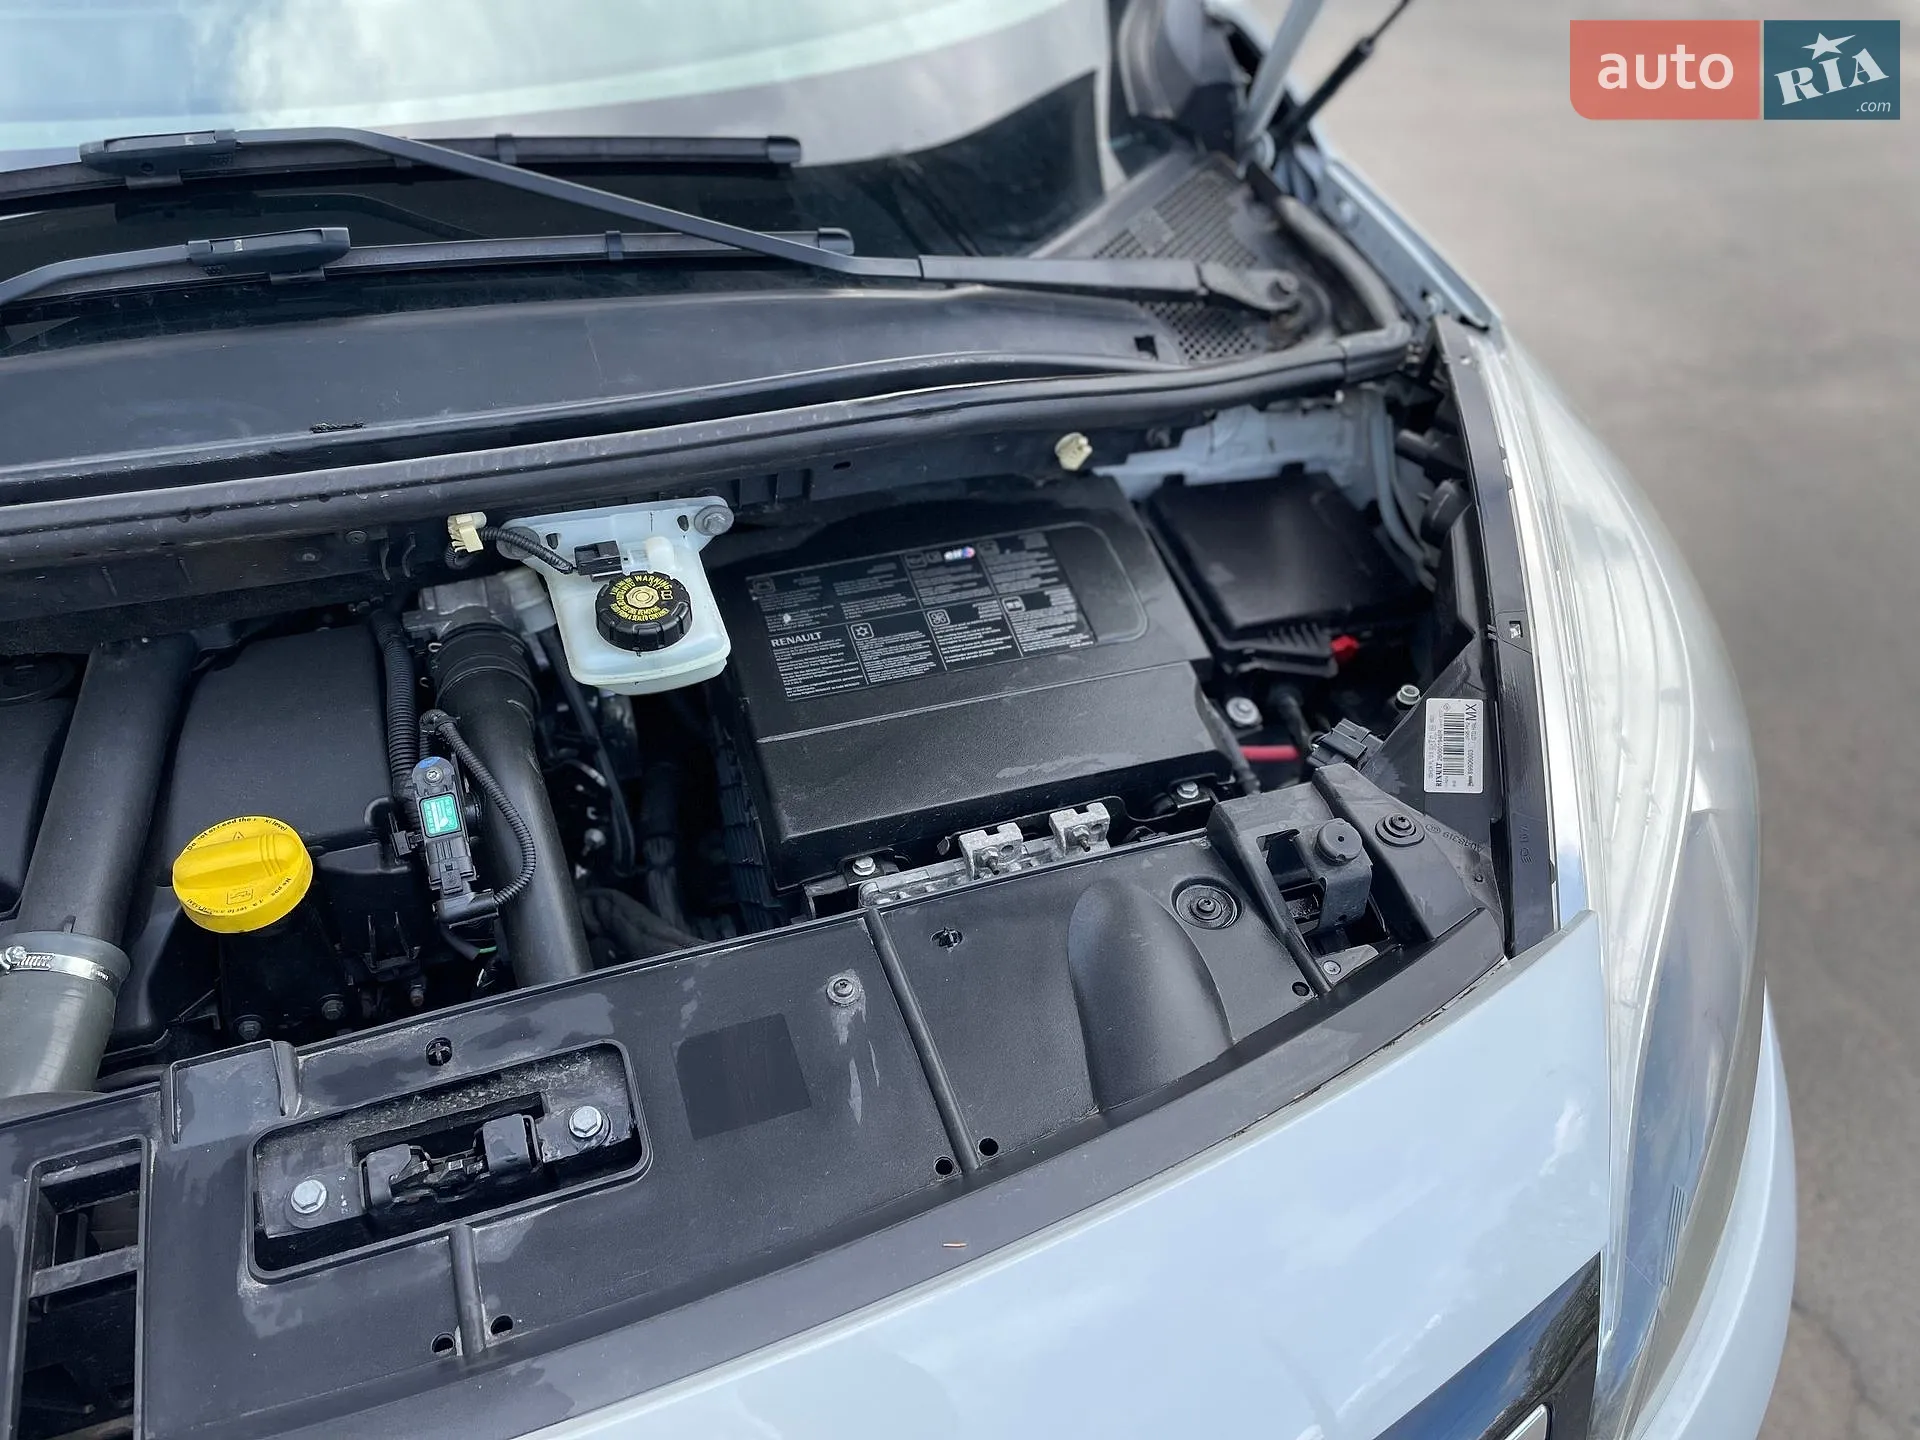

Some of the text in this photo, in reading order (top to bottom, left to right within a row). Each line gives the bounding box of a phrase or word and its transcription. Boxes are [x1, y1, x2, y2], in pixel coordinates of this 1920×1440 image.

[634, 575, 673, 590] WARNING
[770, 631, 822, 647] RENAULT
[1465, 703, 1477, 721] MX
